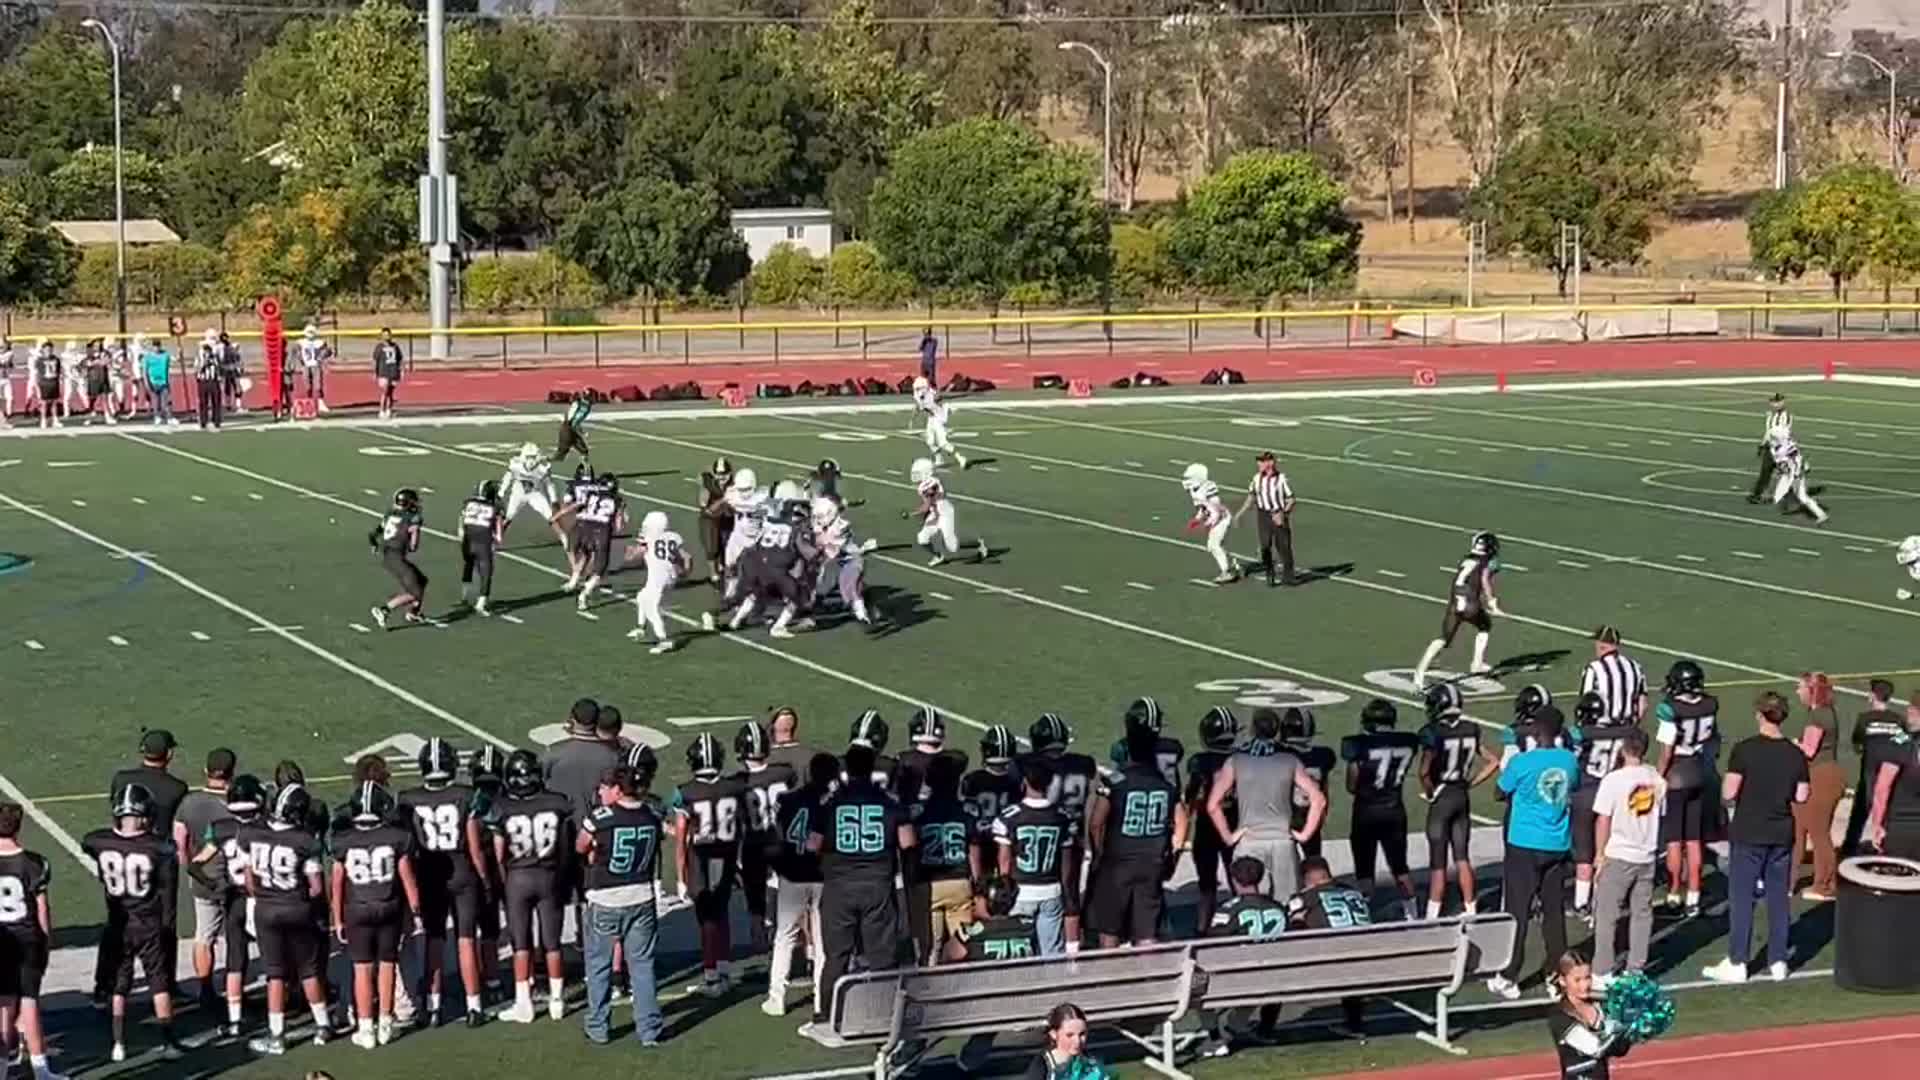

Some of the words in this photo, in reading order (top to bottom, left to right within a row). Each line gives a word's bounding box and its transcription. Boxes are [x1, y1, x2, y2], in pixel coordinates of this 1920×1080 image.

[835, 804, 885, 853] 65
[1121, 790, 1169, 836] 60
[345, 844, 395, 886] 60
[608, 825, 656, 874] 57
[1015, 825, 1060, 873] 37
[98, 850, 153, 898] 80
